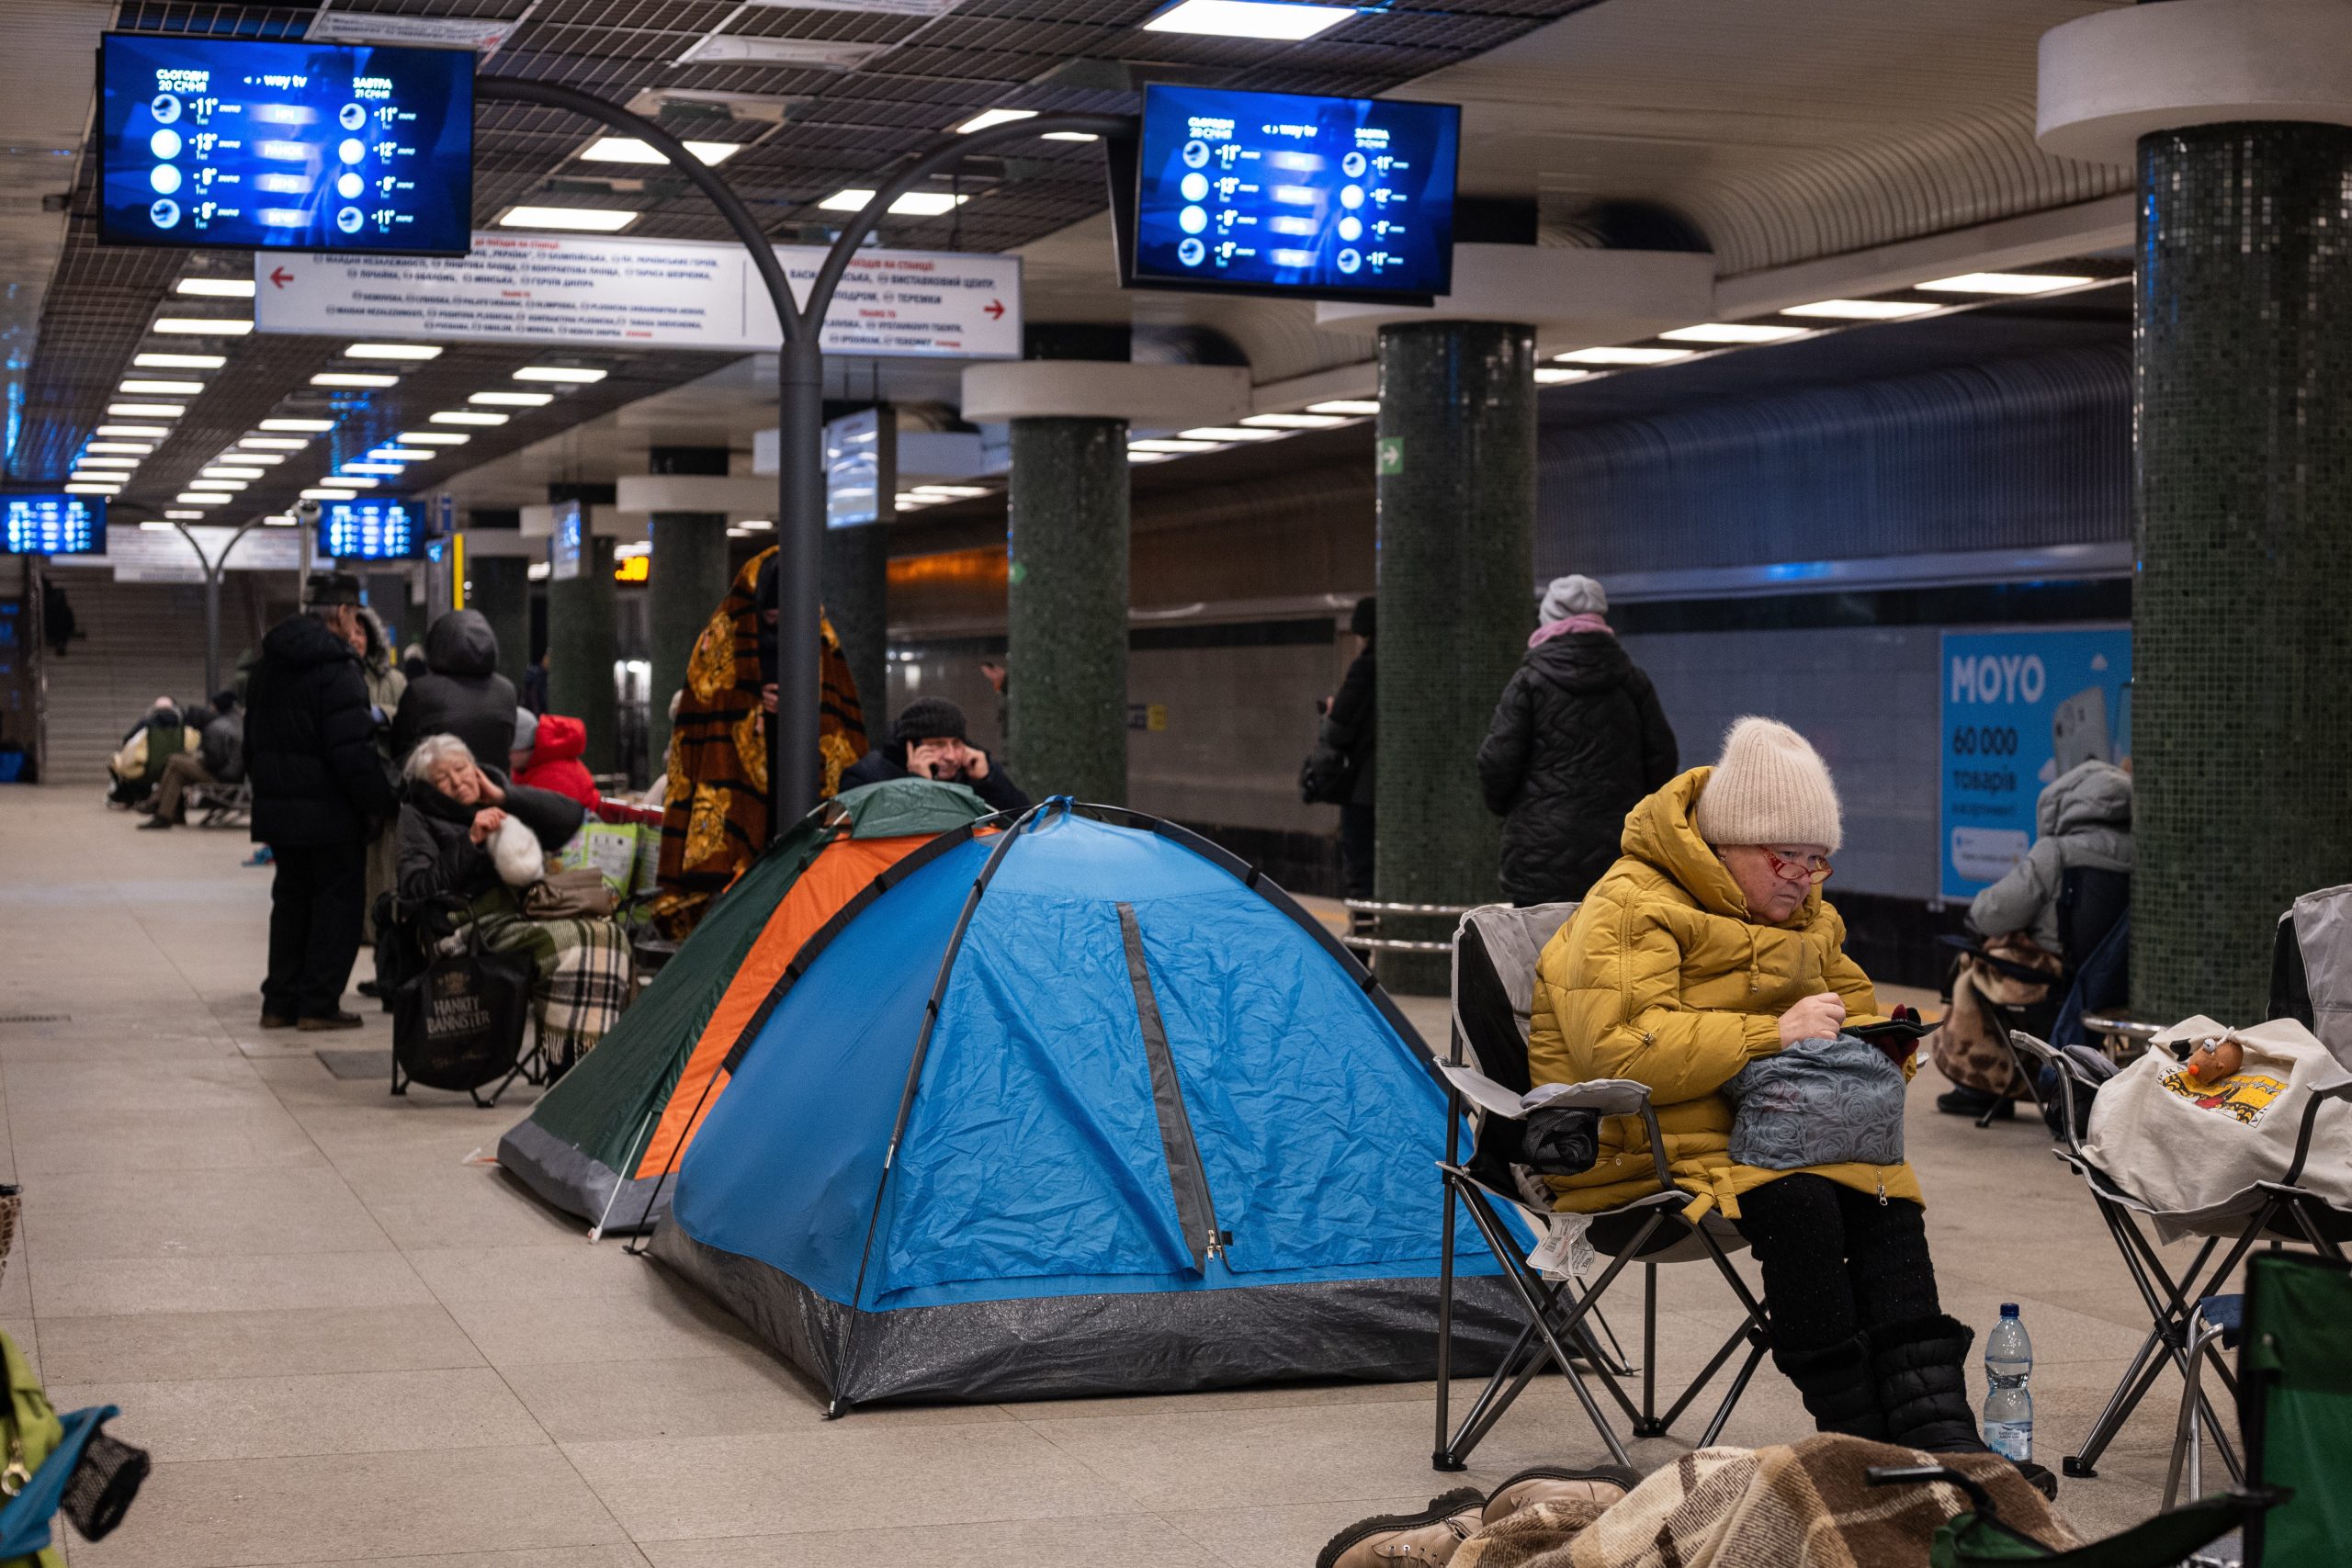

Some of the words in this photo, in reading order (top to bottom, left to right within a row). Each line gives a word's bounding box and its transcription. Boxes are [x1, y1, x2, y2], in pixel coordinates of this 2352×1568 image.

[159, 80, 173, 91] 20
[264, 75, 292, 90] way
[292, 75, 308, 87] tv
[353, 77, 393, 89] ЗАВТРА
[1951, 654, 2046, 705] MOYO
[1953, 726, 1976, 755] 60
[1981, 726, 2018, 755] 000
